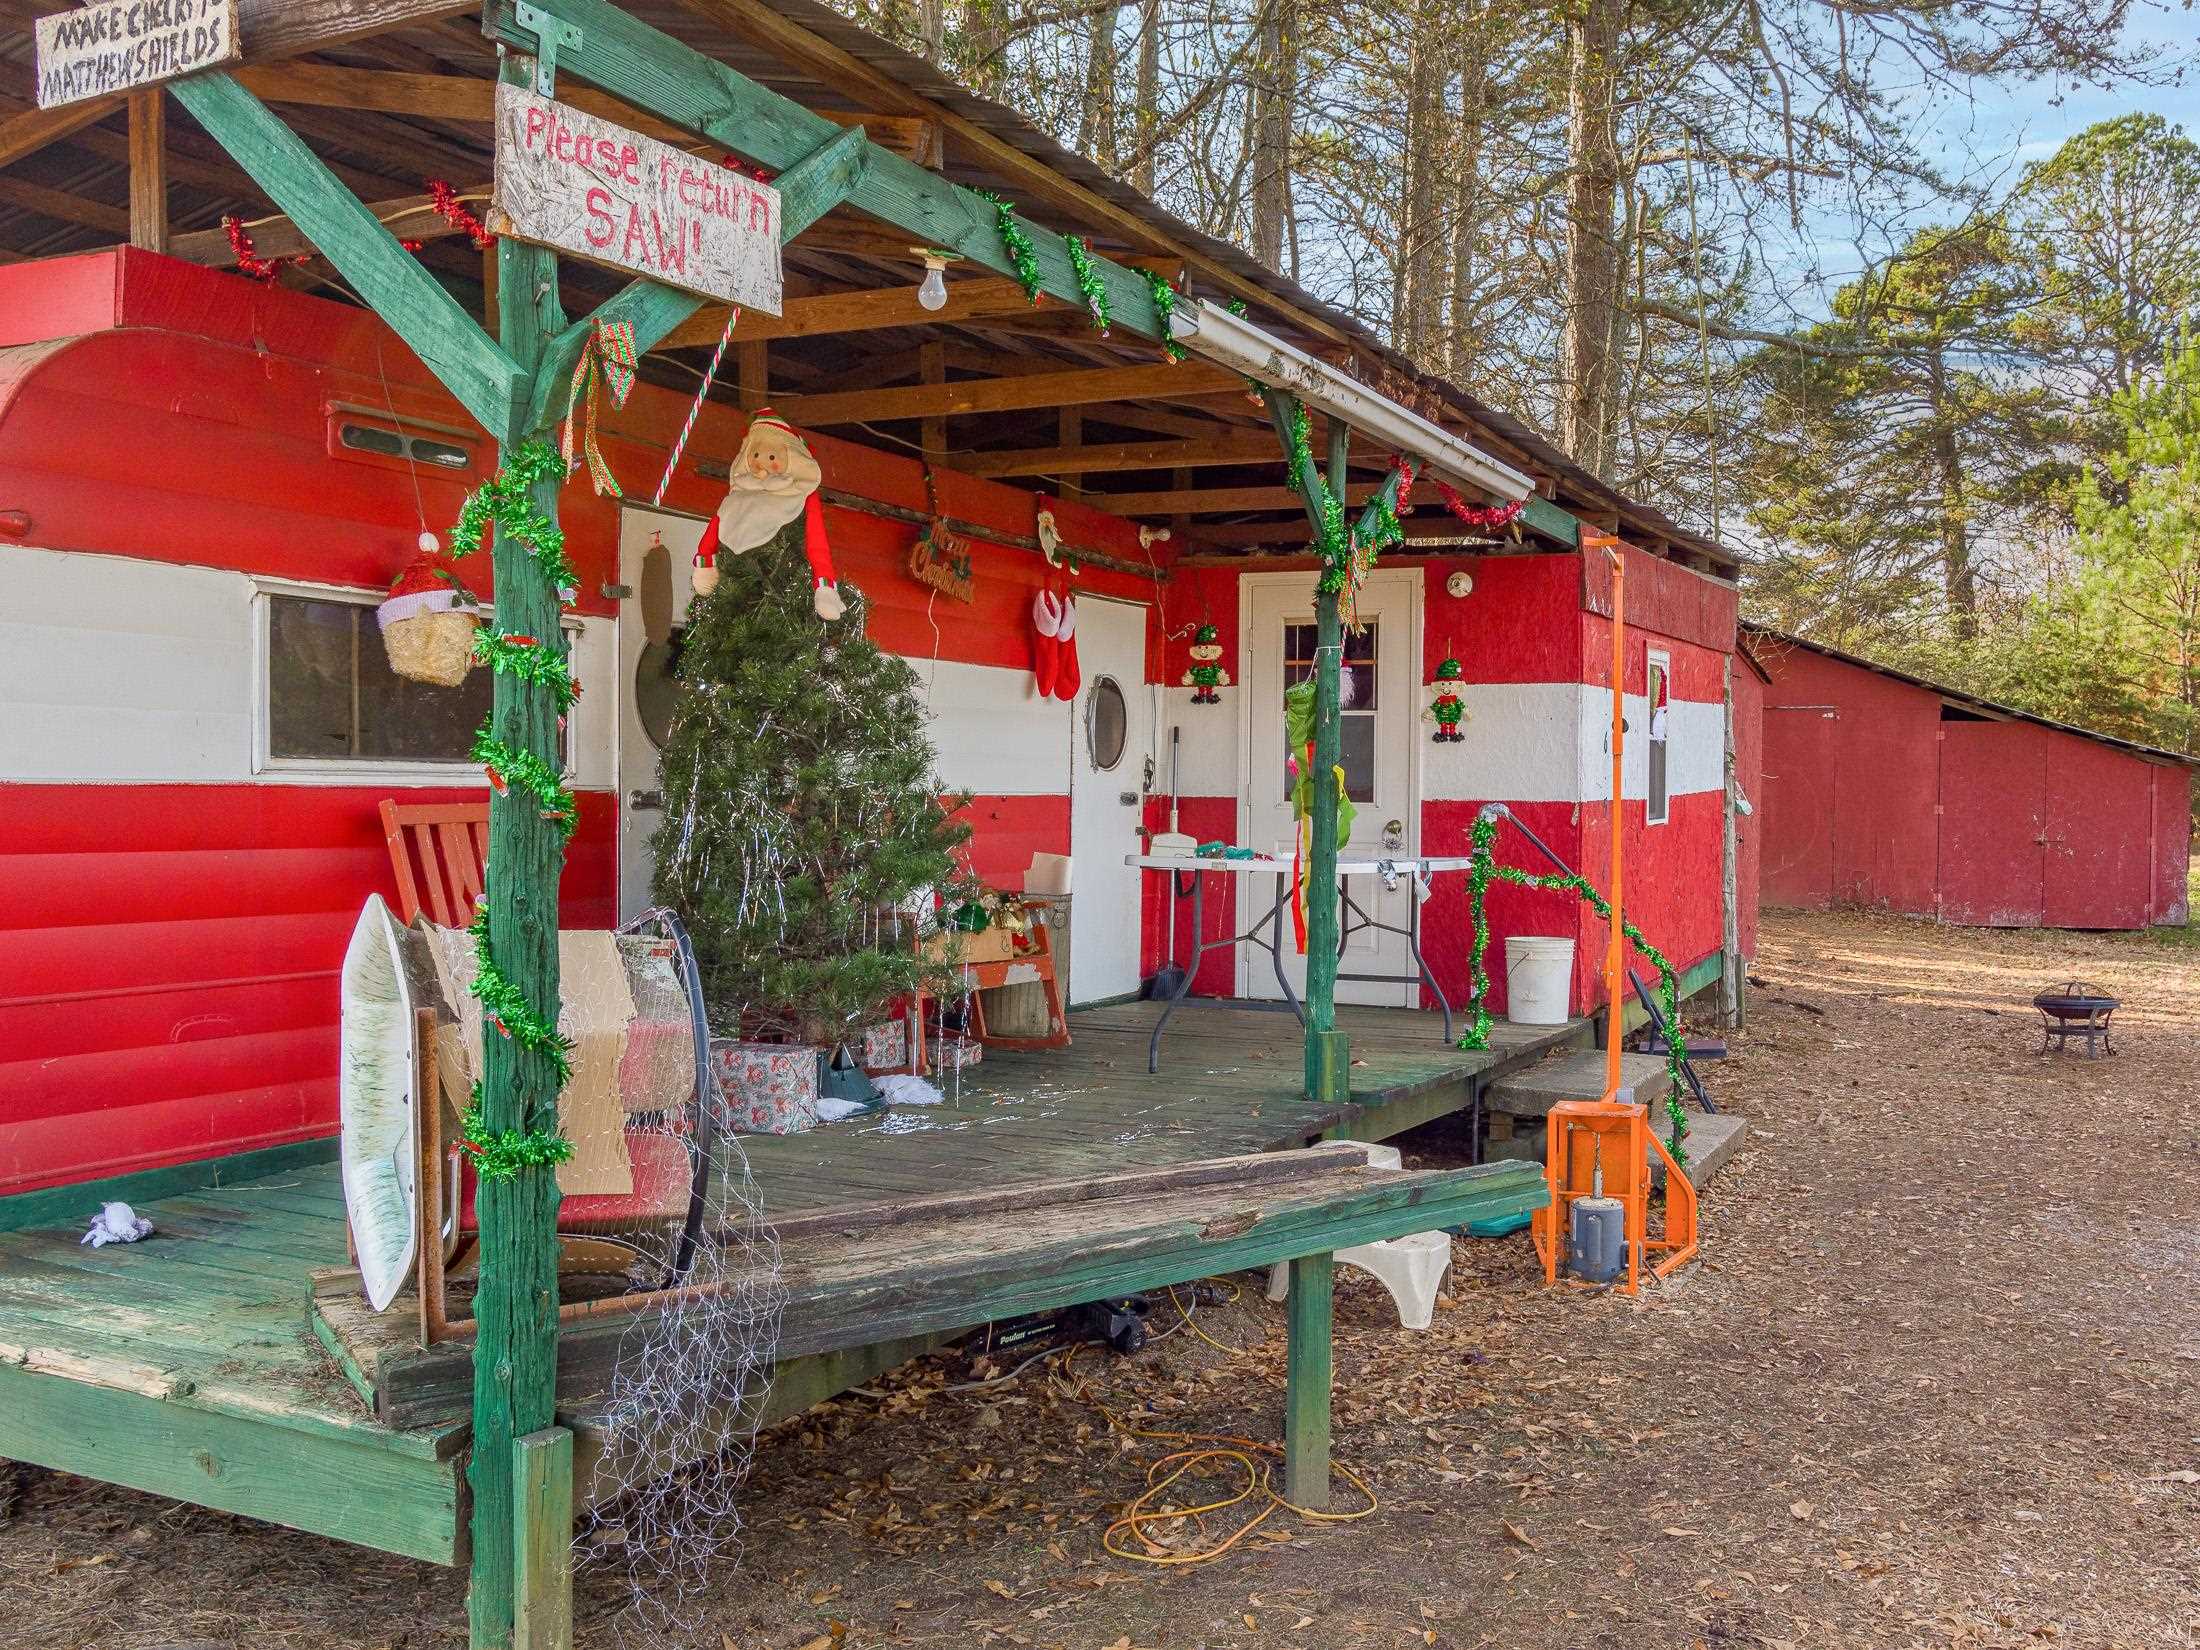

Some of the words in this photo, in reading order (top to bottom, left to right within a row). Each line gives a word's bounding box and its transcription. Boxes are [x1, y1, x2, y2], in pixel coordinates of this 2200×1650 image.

[42, 47, 135, 105] MATTHEW
[134, 16, 221, 79] SHIELDS
[54, 7, 121, 50] MAKE
[526, 107, 640, 186] Please
[659, 154, 771, 236] return
[583, 186, 702, 277] SAW!
